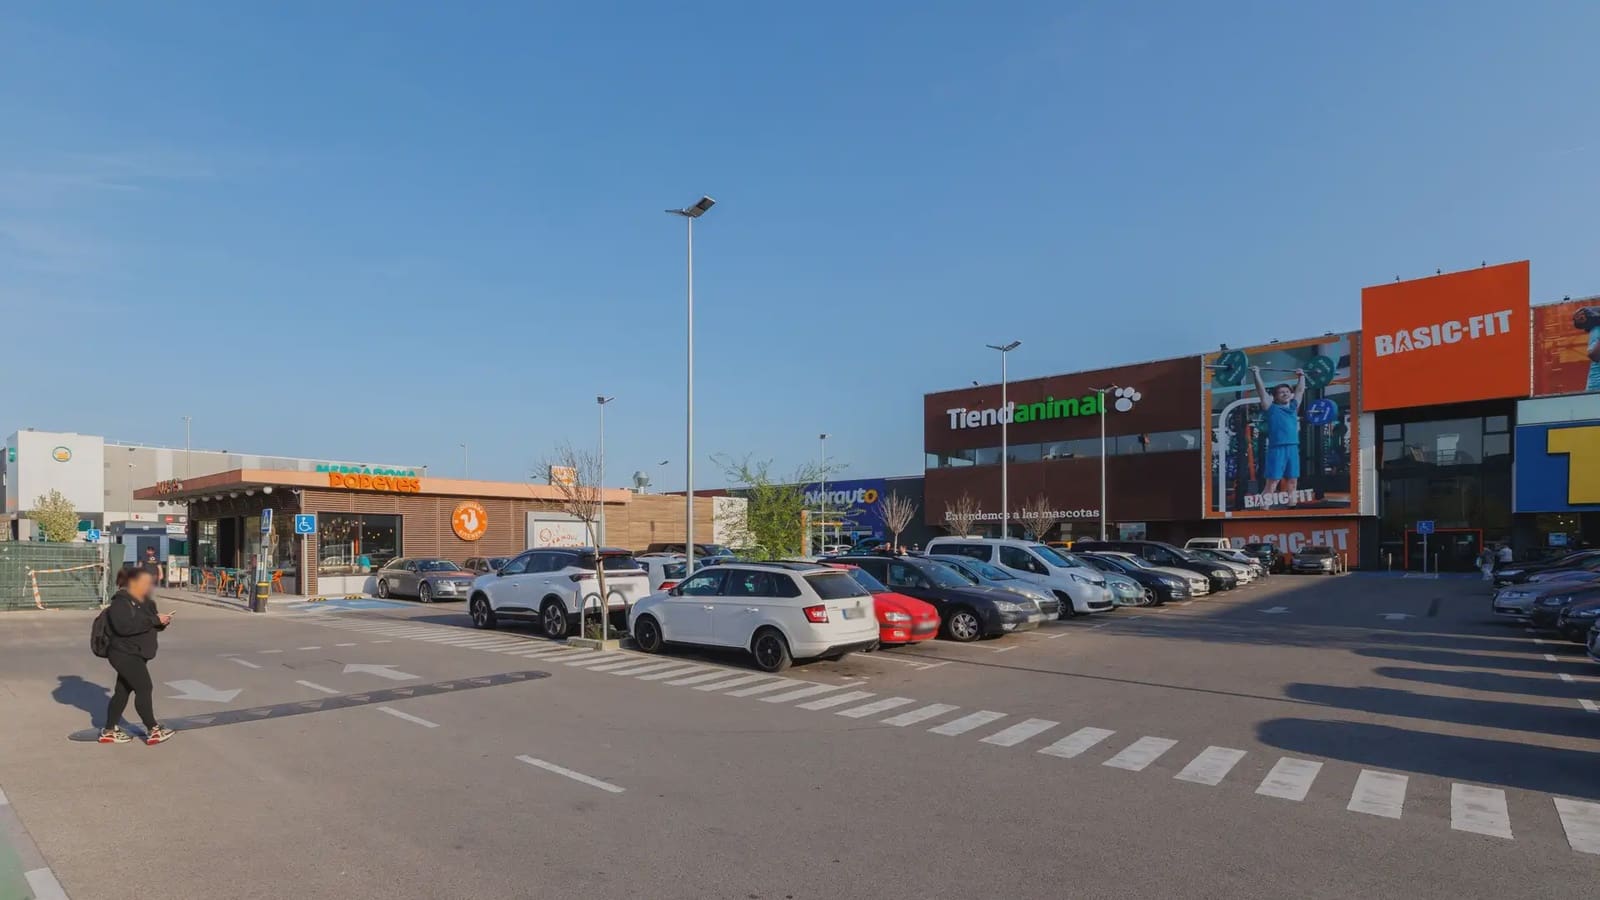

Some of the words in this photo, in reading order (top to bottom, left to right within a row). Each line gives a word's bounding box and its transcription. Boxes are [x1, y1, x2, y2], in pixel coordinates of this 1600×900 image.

[1374, 309, 1513, 357] BASIC-FIT
[946, 390, 1108, 430] Tiendanimal
[804, 487, 879, 506] Norauto
[1243, 488, 1314, 508] BASIC-FIT
[1022, 508, 1039, 519] las
[1041, 508, 1101, 519] mascotas
